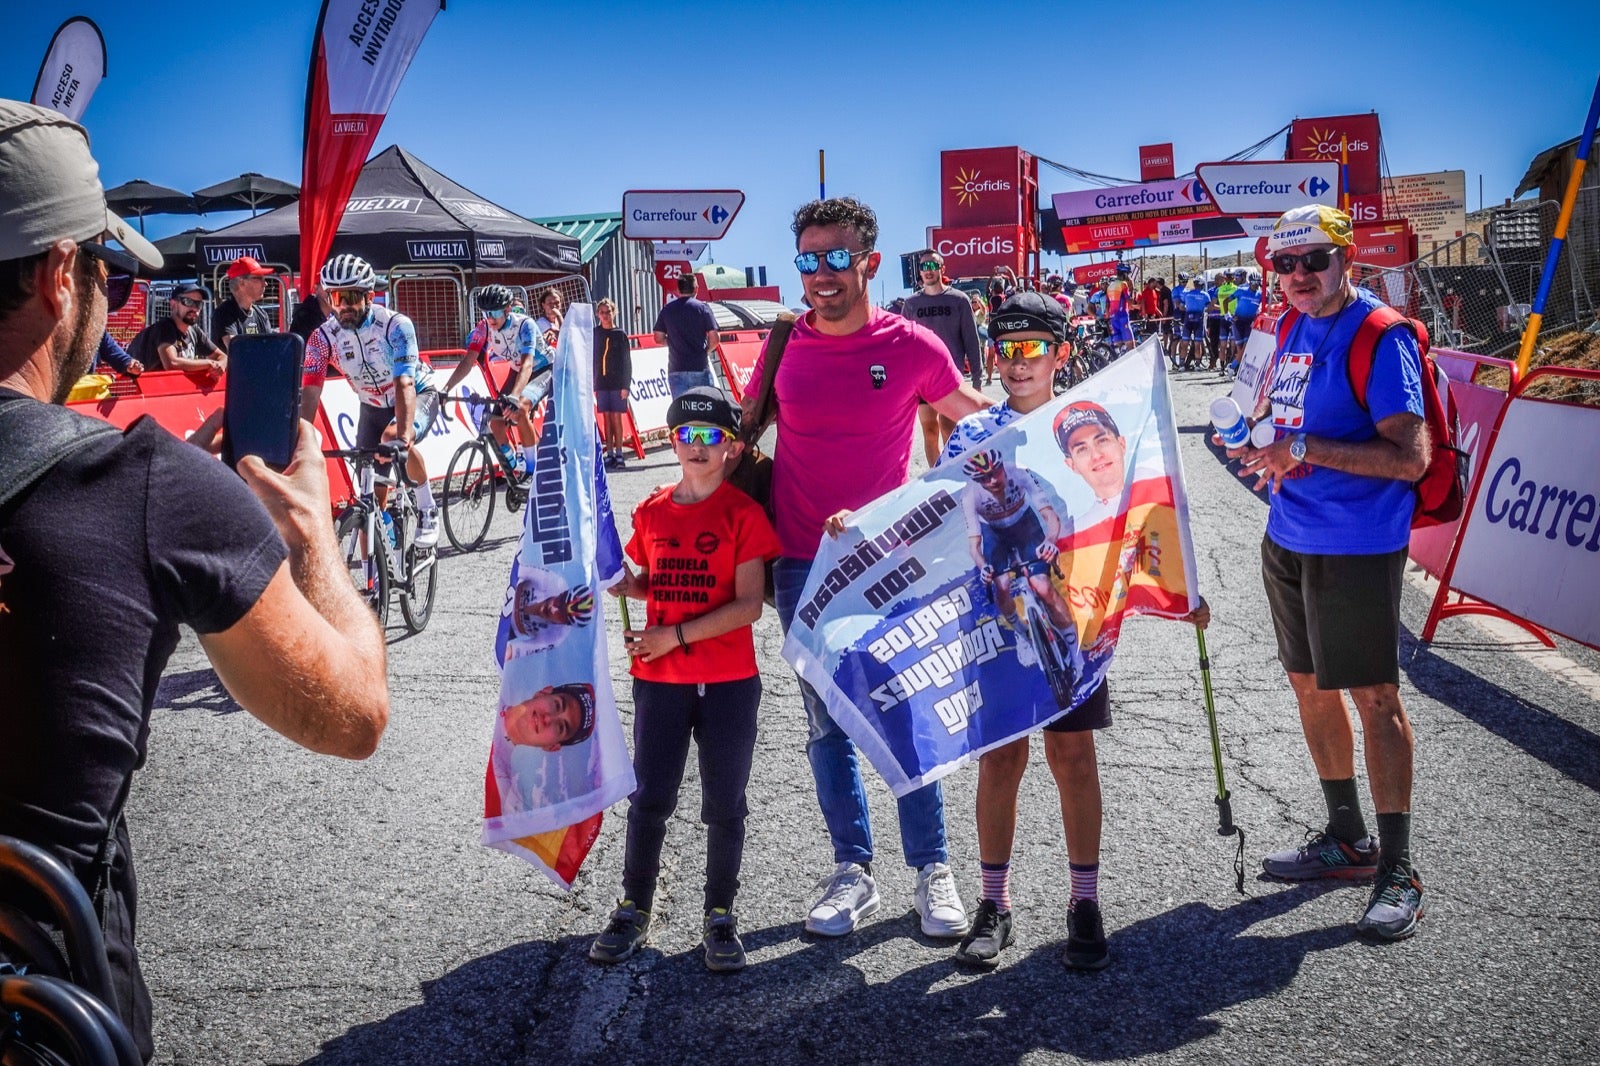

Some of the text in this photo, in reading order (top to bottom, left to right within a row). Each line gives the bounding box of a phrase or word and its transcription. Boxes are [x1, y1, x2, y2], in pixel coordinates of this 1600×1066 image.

[349, 0, 380, 48] ACCES
[362, 0, 405, 66] INVITADO
[51, 63, 73, 109] ACCESO
[63, 79, 80, 108] META
[334, 121, 364, 133] LA VUELTA
[1317, 140, 1369, 154] Cofdis
[964, 180, 1011, 192] Cofidis
[1215, 180, 1292, 196] Carrefour
[1095, 189, 1175, 209] Carrefour
[632, 208, 698, 222] Carrefour
[1065, 218, 1081, 226] META
[1086, 216, 1107, 224] SIERRA
[1131, 212, 1144, 220] ALTO
[1093, 226, 1129, 238] LA VUELTA
[1161, 228, 1190, 237] TISSOT
[1273, 226, 1312, 239] SEMAR
[413, 243, 465, 257] LA VUELTA
[937, 235, 1014, 257] Cofidis
[210, 248, 223, 261] LA
[663, 265, 682, 279] 25
[1087, 269, 1115, 278] Cofidis
[916, 305, 951, 318] GUESS
[997, 319, 1030, 330] INEOS
[630, 368, 671, 402] Carref
[681, 400, 713, 411] INEOS
[656, 557, 709, 571] ESCUELA
[653, 590, 709, 603] SEXITANA
